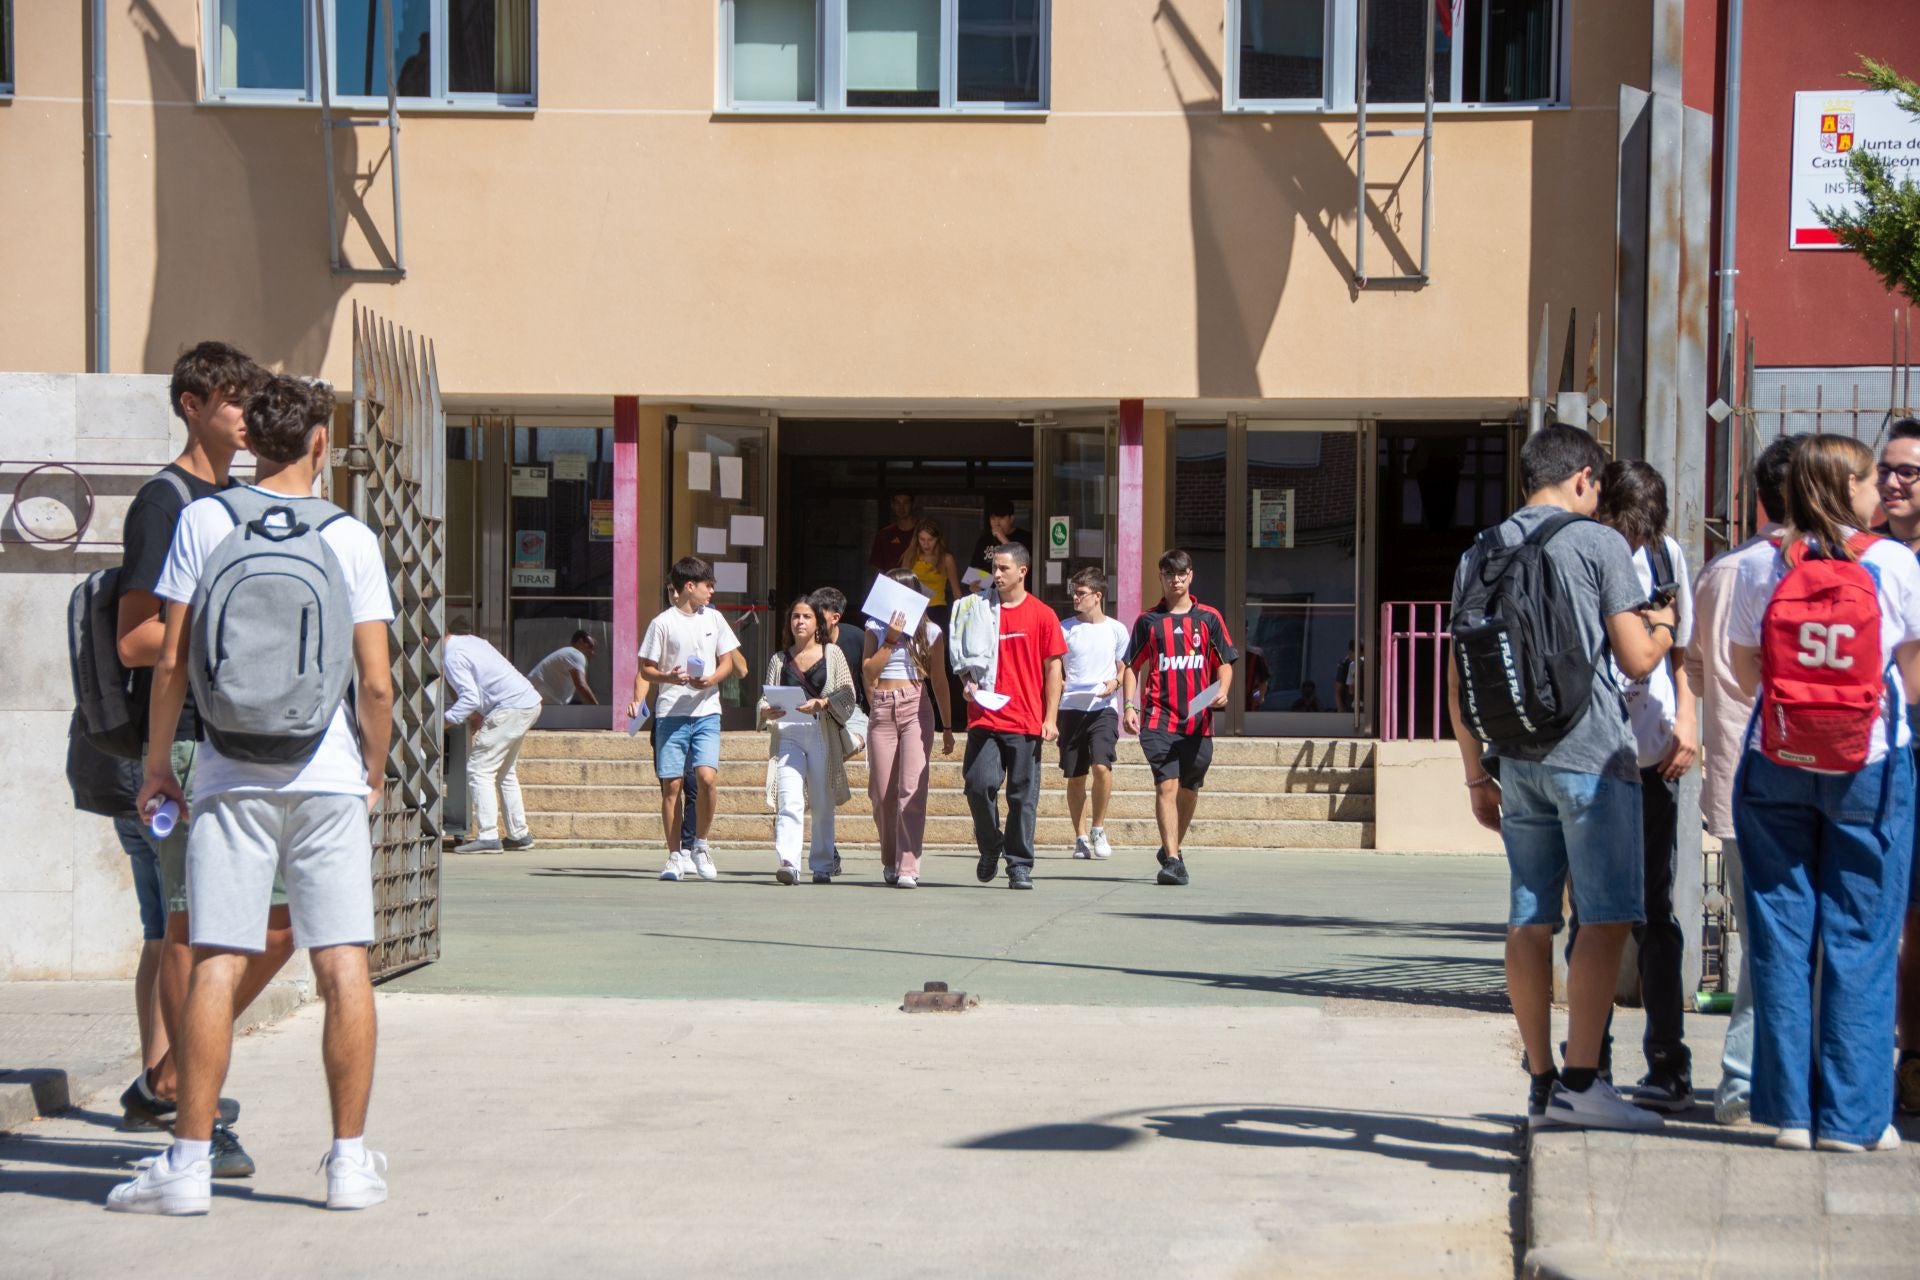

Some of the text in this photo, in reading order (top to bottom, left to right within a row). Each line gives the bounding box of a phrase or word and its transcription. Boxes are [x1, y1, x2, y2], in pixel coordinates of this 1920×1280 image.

[1862, 139, 1902, 150] Junta
[517, 574, 550, 584] TIRAR
[1159, 652, 1205, 672] bwin
[1797, 622, 1856, 669] SC
[1462, 653, 1472, 677] FILA
[1467, 690, 1478, 715] FILA
[1501, 642, 1513, 668] FILA
[1508, 679, 1521, 704] FILA
